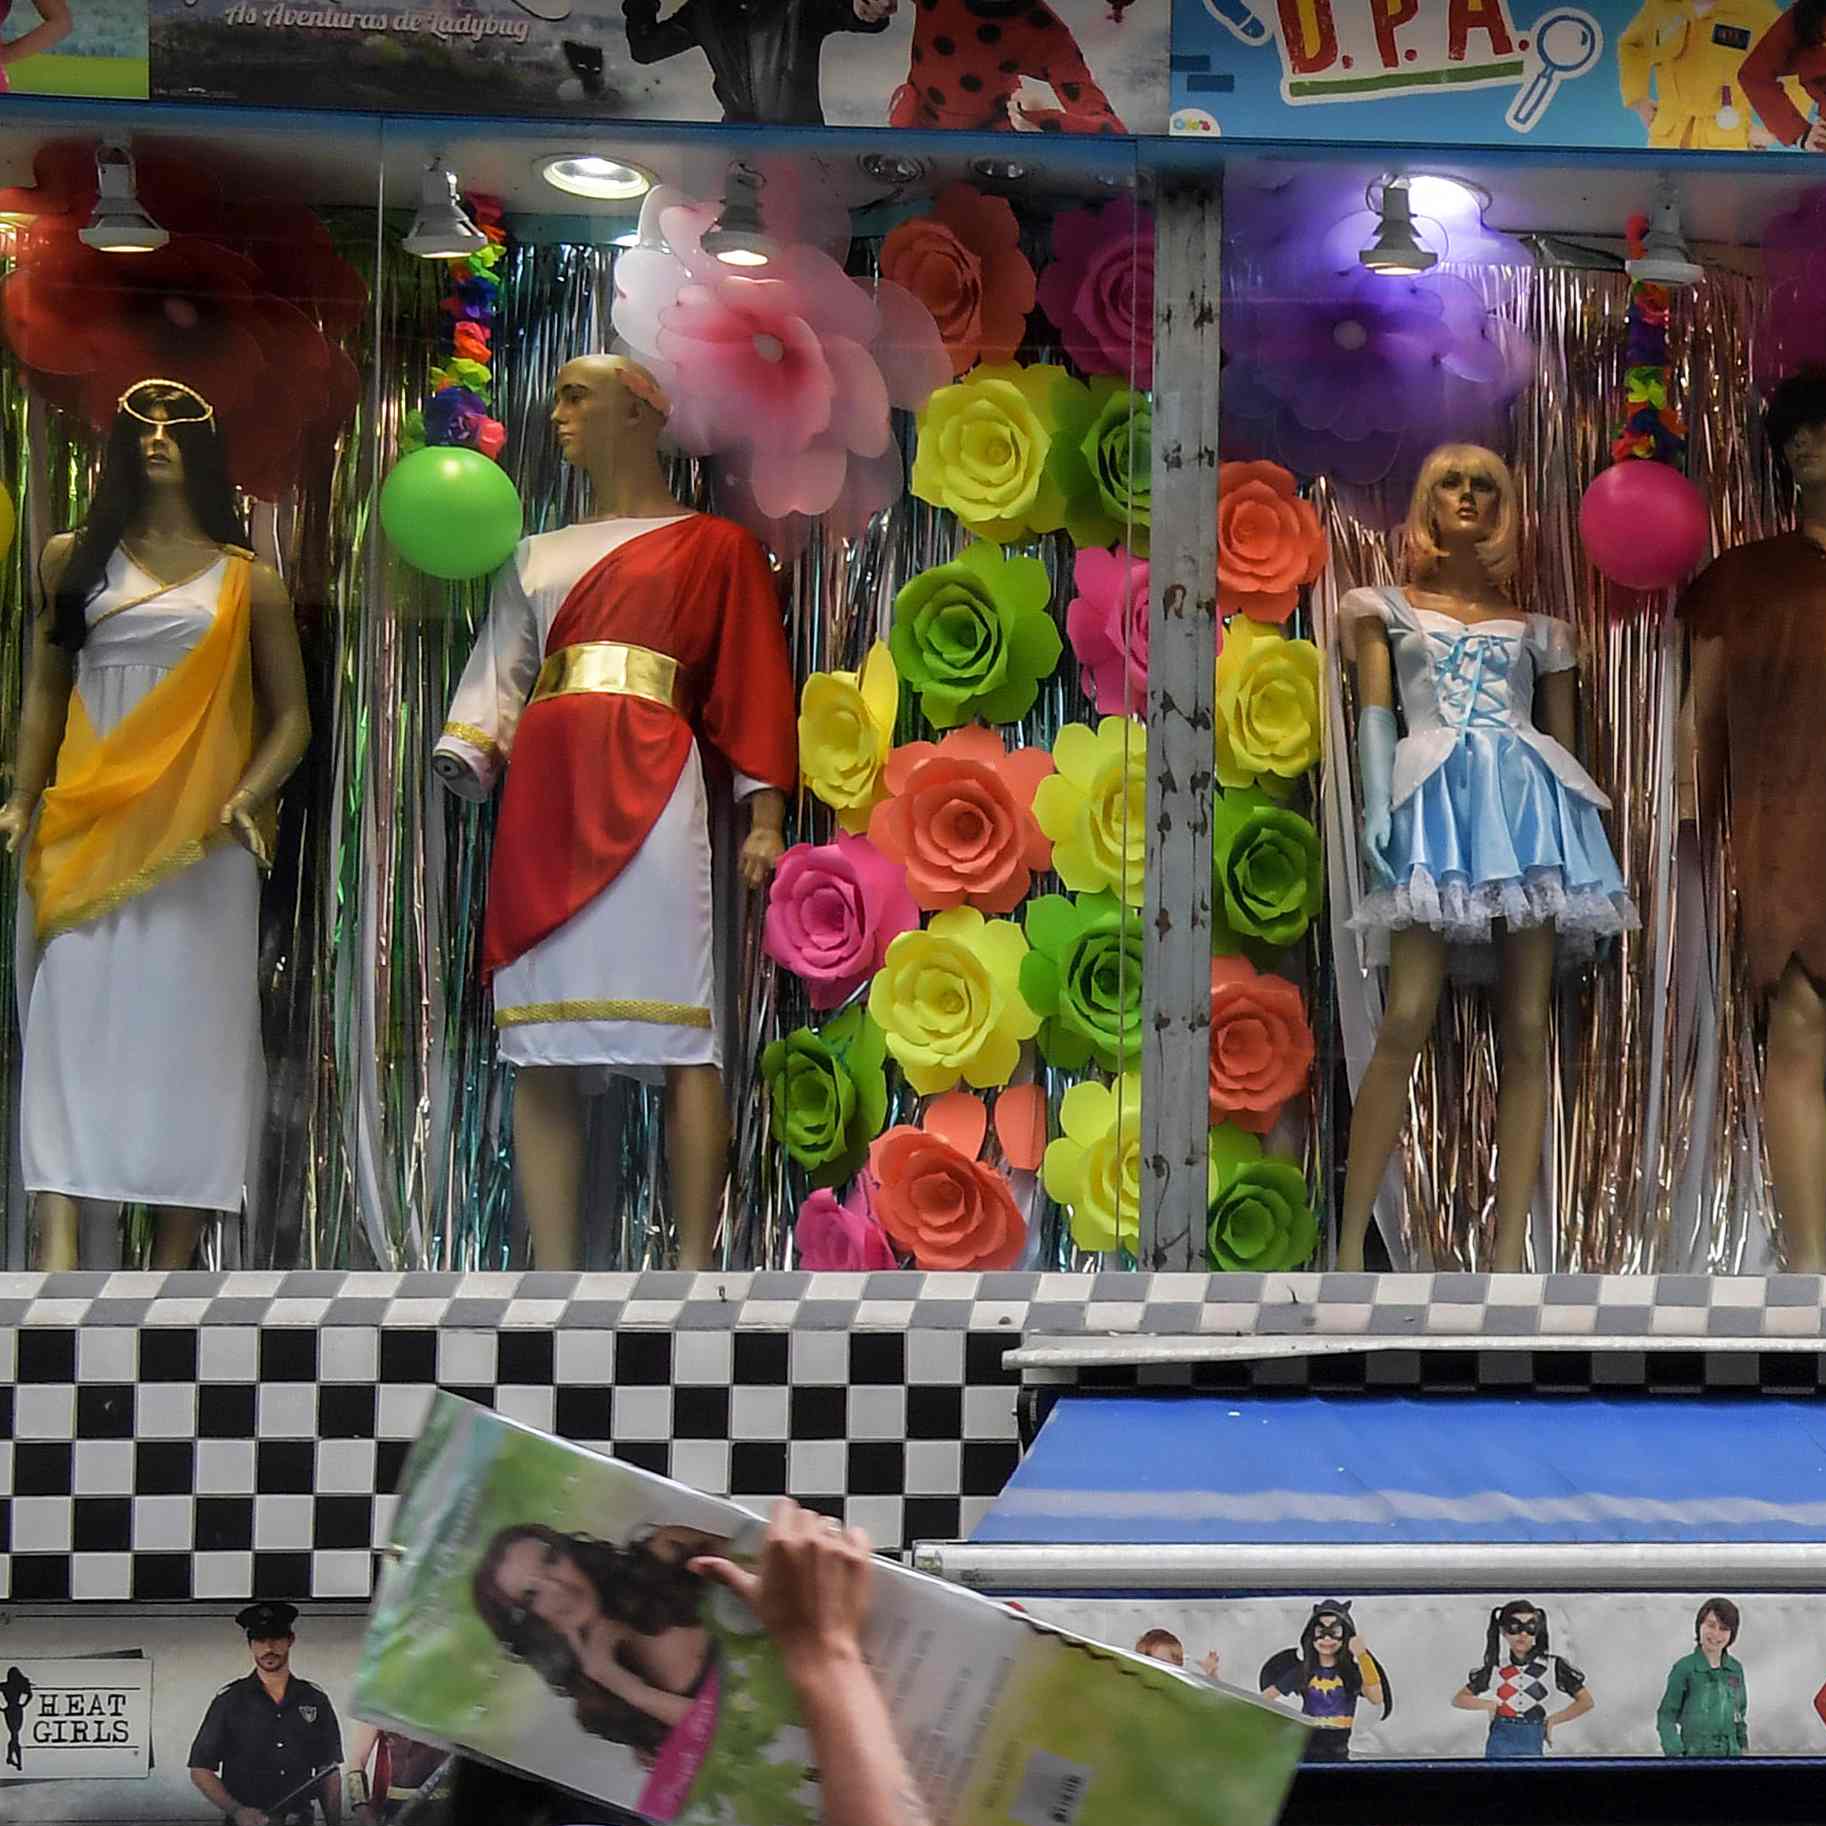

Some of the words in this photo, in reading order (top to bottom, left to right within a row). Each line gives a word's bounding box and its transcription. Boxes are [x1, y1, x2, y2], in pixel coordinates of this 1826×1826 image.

[225, 4, 257, 26] As
[263, 8, 388, 32] Aventuras
[394, 15, 421, 33] de
[424, 16, 530, 43] Ladybug
[38, 1694, 126, 1717] HEAT
[33, 1720, 128, 1743] GIRLS
